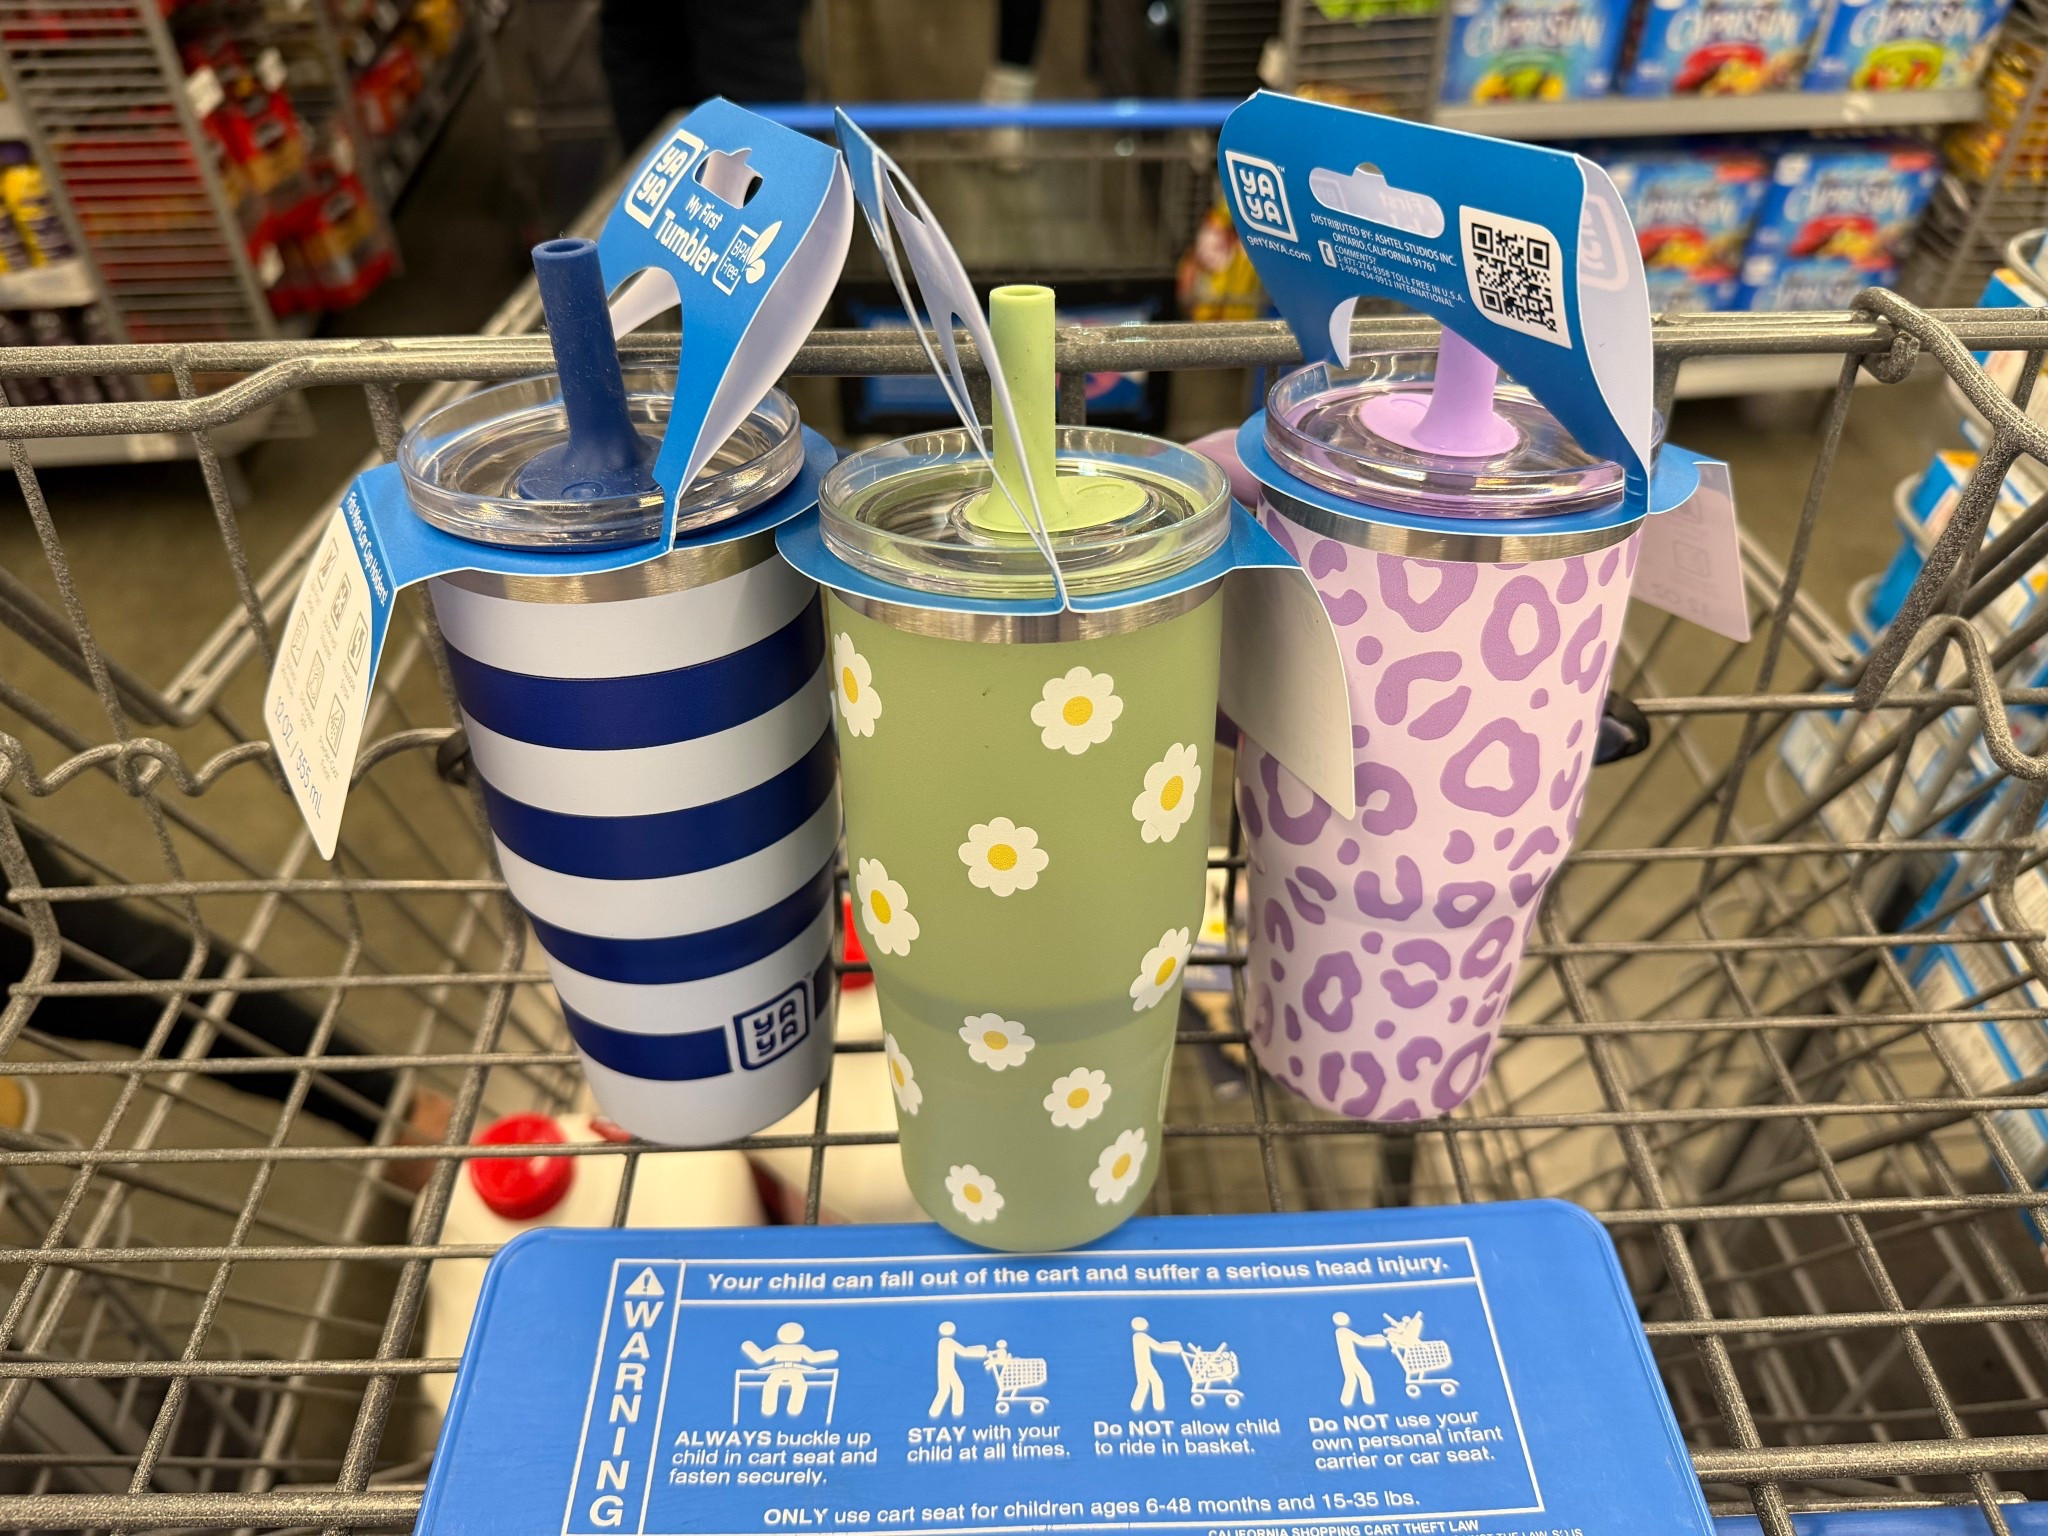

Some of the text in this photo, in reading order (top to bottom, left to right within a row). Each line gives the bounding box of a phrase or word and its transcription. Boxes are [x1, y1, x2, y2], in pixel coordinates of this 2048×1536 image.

[656, 146, 689, 178] YA
[636, 174, 667, 207] YA
[1239, 169, 1276, 200] YA
[685, 194, 723, 231] My First
[1245, 195, 1282, 226] YA
[655, 209, 719, 276] Tumbler
[731, 239, 751, 264] BPA
[1246, 235, 1312, 262] getYAYA.com
[1310, 213, 1457, 266] DISTRIBUTED BY: ASHTEL STUDIOS INC.
[1332, 232, 1437, 272] ONTARIO, CALIFORNIA 91761
[720, 257, 739, 281] Free
[1334, 245, 1376, 265] COMMENTS?
[1337, 255, 1466, 304] 1-877-274-8358 TOLL FREE IN U.S.A.
[1393, 281, 1455, 308] INTERNATIONAL
[364, 541, 374, 570] Cup
[275, 696, 285, 724] 12
[282, 714, 294, 748] OZ
[296, 748, 311, 788] 355
[309, 783, 322, 819] mL
[753, 998, 797, 1037] YA
[756, 1018, 798, 1057] YA
[708, 1255, 1449, 1291] Your child can fall out of the cart and suffer a serious head injury.
[589, 1300, 665, 1528] WARNING
[1093, 1418, 1281, 1438] Do NOT allow child
[1308, 1410, 1479, 1434] Do NOT use your
[674, 1429, 872, 1450] ALWAYS buckle up
[908, 1424, 1060, 1444] STAY with your
[1094, 1437, 1255, 1457] to ride in basket.
[1311, 1425, 1504, 1452] own personal infant
[671, 1447, 878, 1466] child in cart seat and
[906, 1441, 1070, 1463] child at all times.
[1315, 1445, 1495, 1470] carrier or car seat.
[669, 1467, 827, 1487] fasten securely.
[763, 1490, 1420, 1526] ONLY use cart seat for children ages 6-48 months and 15-35 lbs.
[1291, 1525, 1361, 1536] SHOPPING
[1363, 1523, 1400, 1536] CART
[1402, 1521, 1446, 1535] THEFT
[1448, 1519, 1479, 1533] LAW
